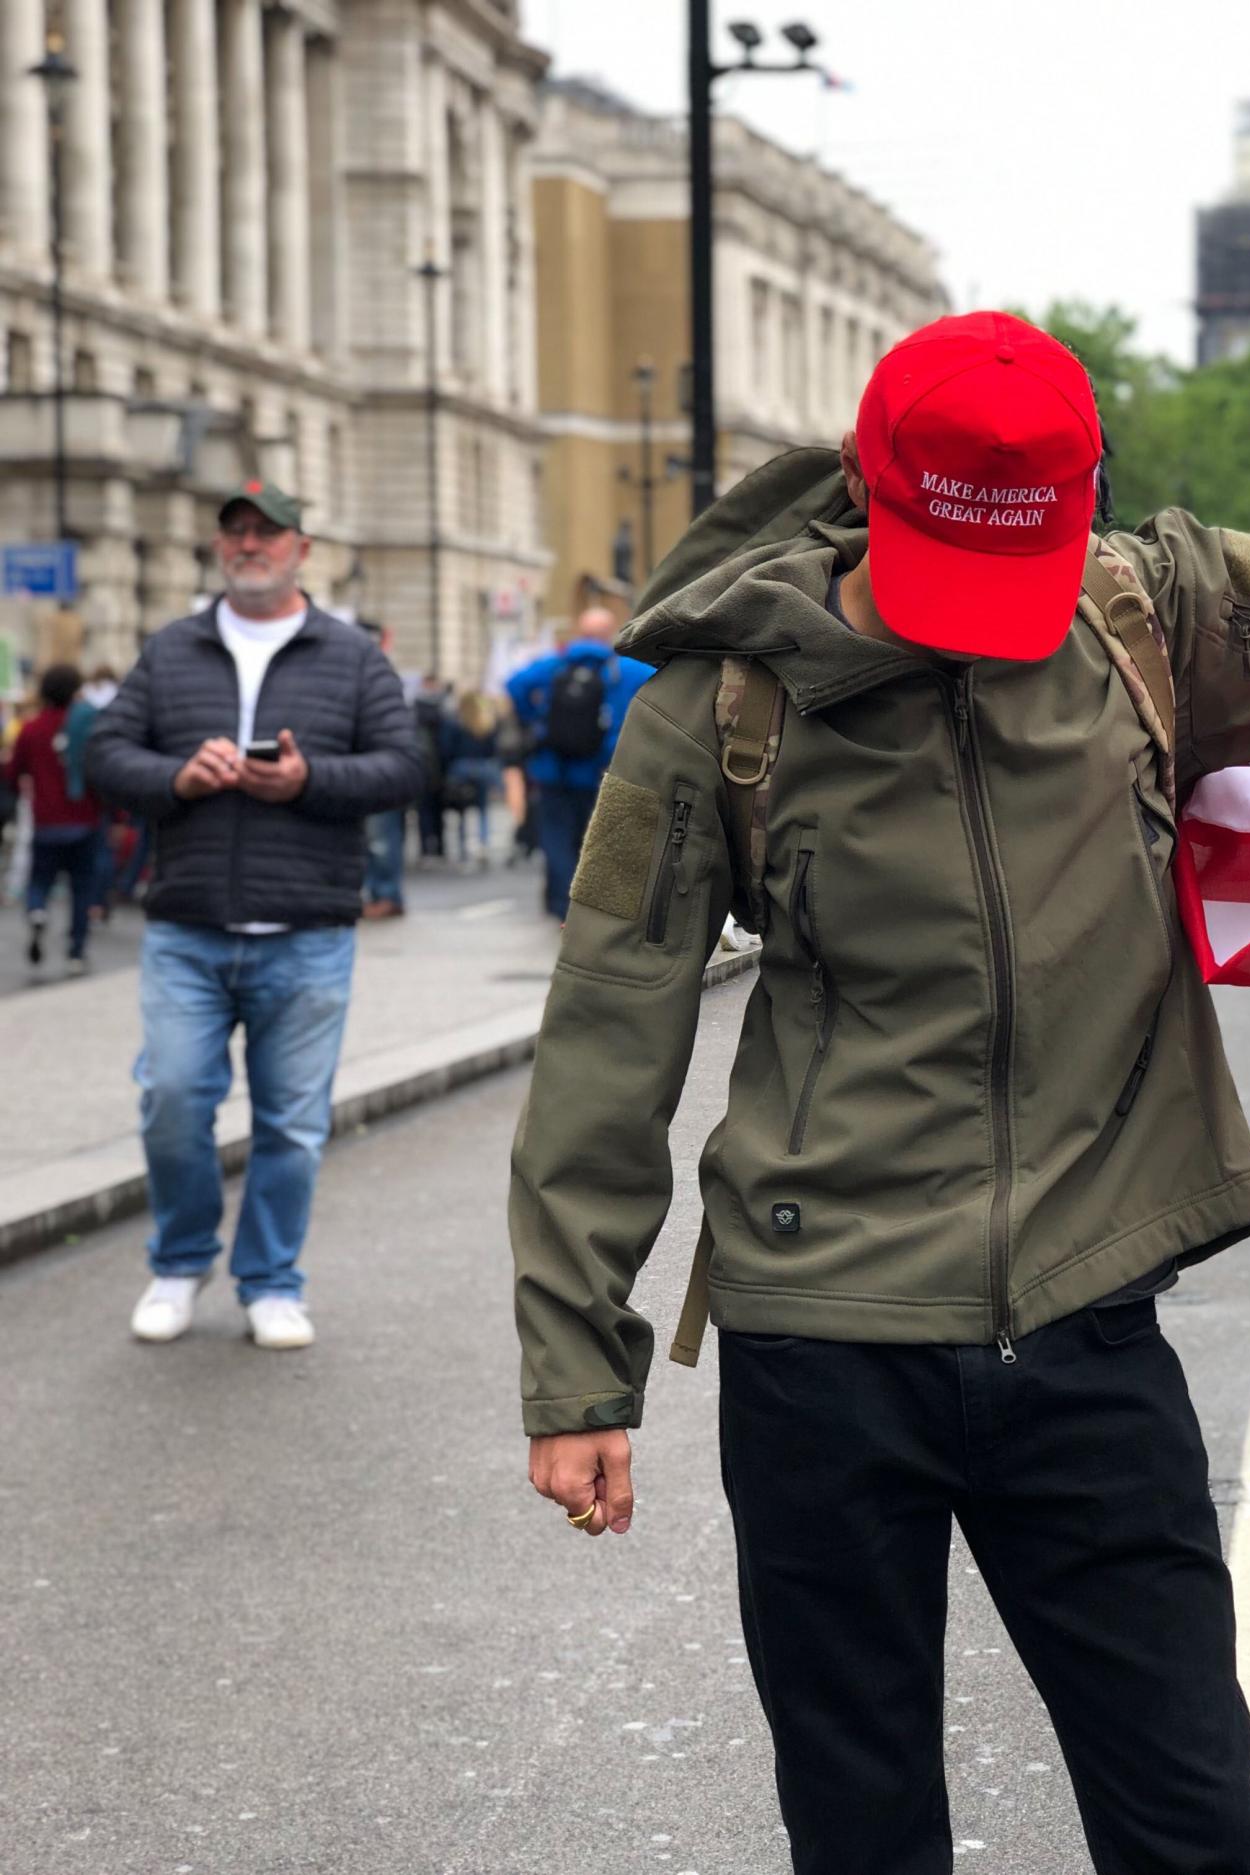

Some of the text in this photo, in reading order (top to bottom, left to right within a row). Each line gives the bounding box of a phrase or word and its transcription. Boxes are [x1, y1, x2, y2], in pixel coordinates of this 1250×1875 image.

[921, 471, 1057, 503] MAKE AMERICA
[929, 499, 1045, 526] GREAT AGAIN
